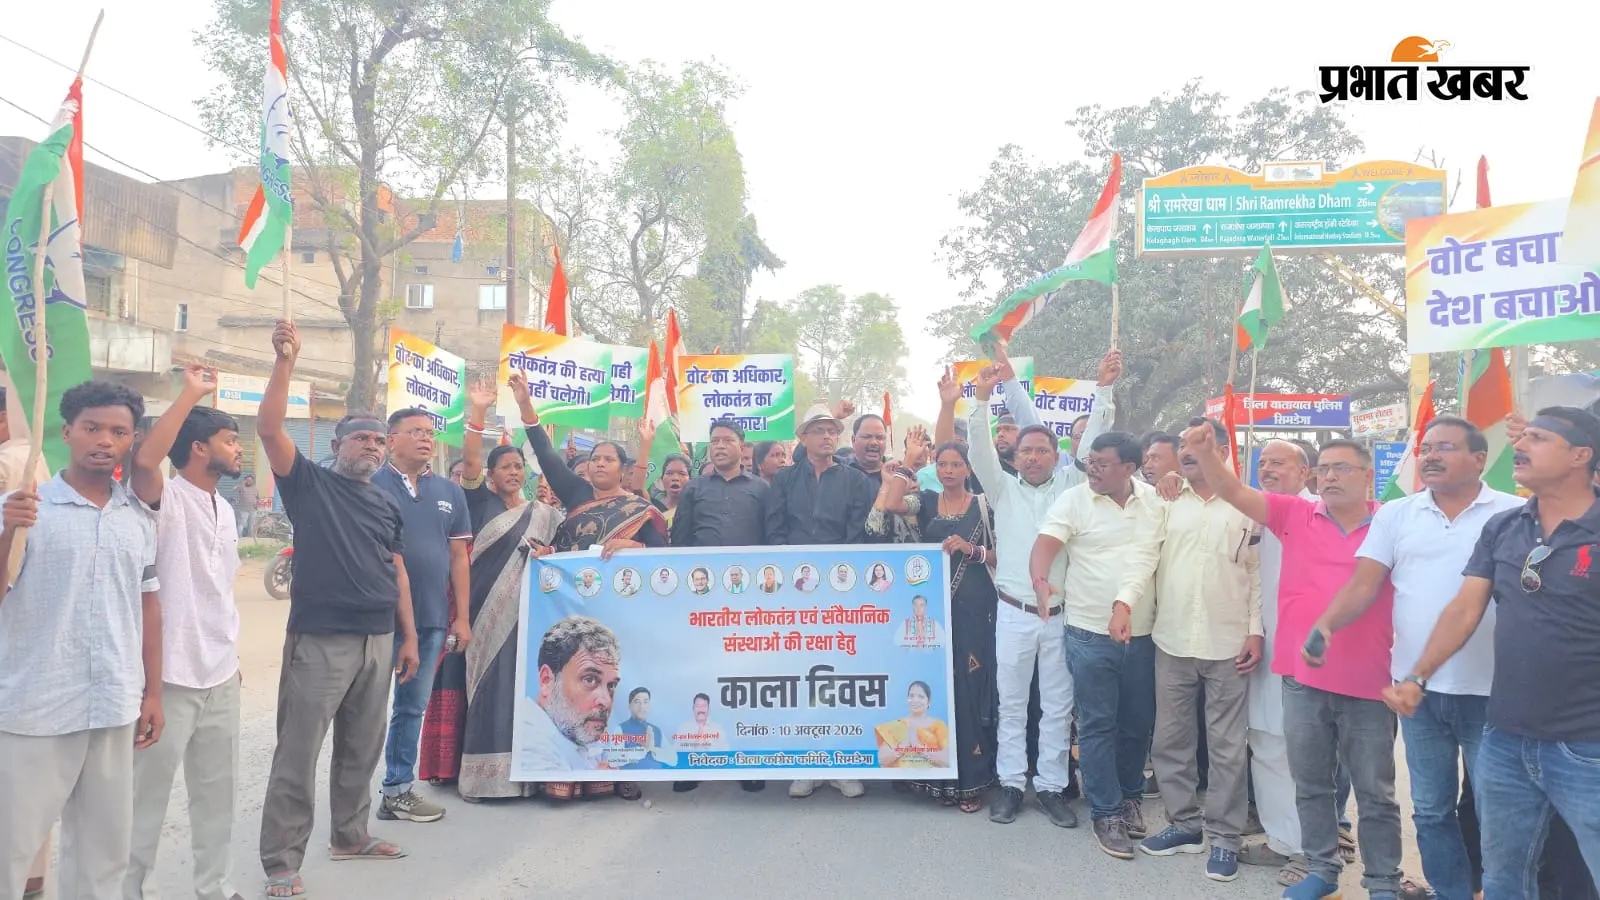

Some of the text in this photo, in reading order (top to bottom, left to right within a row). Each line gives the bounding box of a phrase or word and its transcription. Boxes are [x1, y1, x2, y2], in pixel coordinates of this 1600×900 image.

[1362, 168, 1407, 177] WELCOME
[1148, 193, 1226, 213] श्री रामरेखा धाम
[1236, 193, 1352, 210] Shri Ramrekha Dham
[1427, 232, 1563, 276] वोट बचा
[1426, 272, 1600, 327] देश बचाओ
[395, 342, 461, 388] वोट का अधिकार,
[509, 352, 606, 384] लोकतंत्र की हत्या
[686, 365, 786, 384] वोट का अधिकार,
[406, 375, 451, 408] लोकतंत्र का
[550, 384, 591, 406] चलेगी।
[702, 389, 772, 408] लोकतंत्र का
[1035, 390, 1056, 410] वोट
[1243, 396, 1343, 412] जिला यातायात पुलिस
[1274, 412, 1311, 425] सिमडेगा
[690, 604, 890, 626] भारतीय लोकतंत्र एवं संवैधानिक
[723, 630, 856, 656] संस्थाओं की रक्षा हेतु
[718, 664, 888, 709] काला दिवस
[736, 722, 769, 737] दिनांक
[780, 726, 791, 736] 10
[794, 725, 831, 740] अक्टूबर
[834, 725, 863, 736] 2026
[688, 752, 728, 767] निवेदक
[736, 752, 761, 766] जिला
[764, 752, 794, 766] कांग्रेस
[835, 752, 874, 766] सिमडेगा
